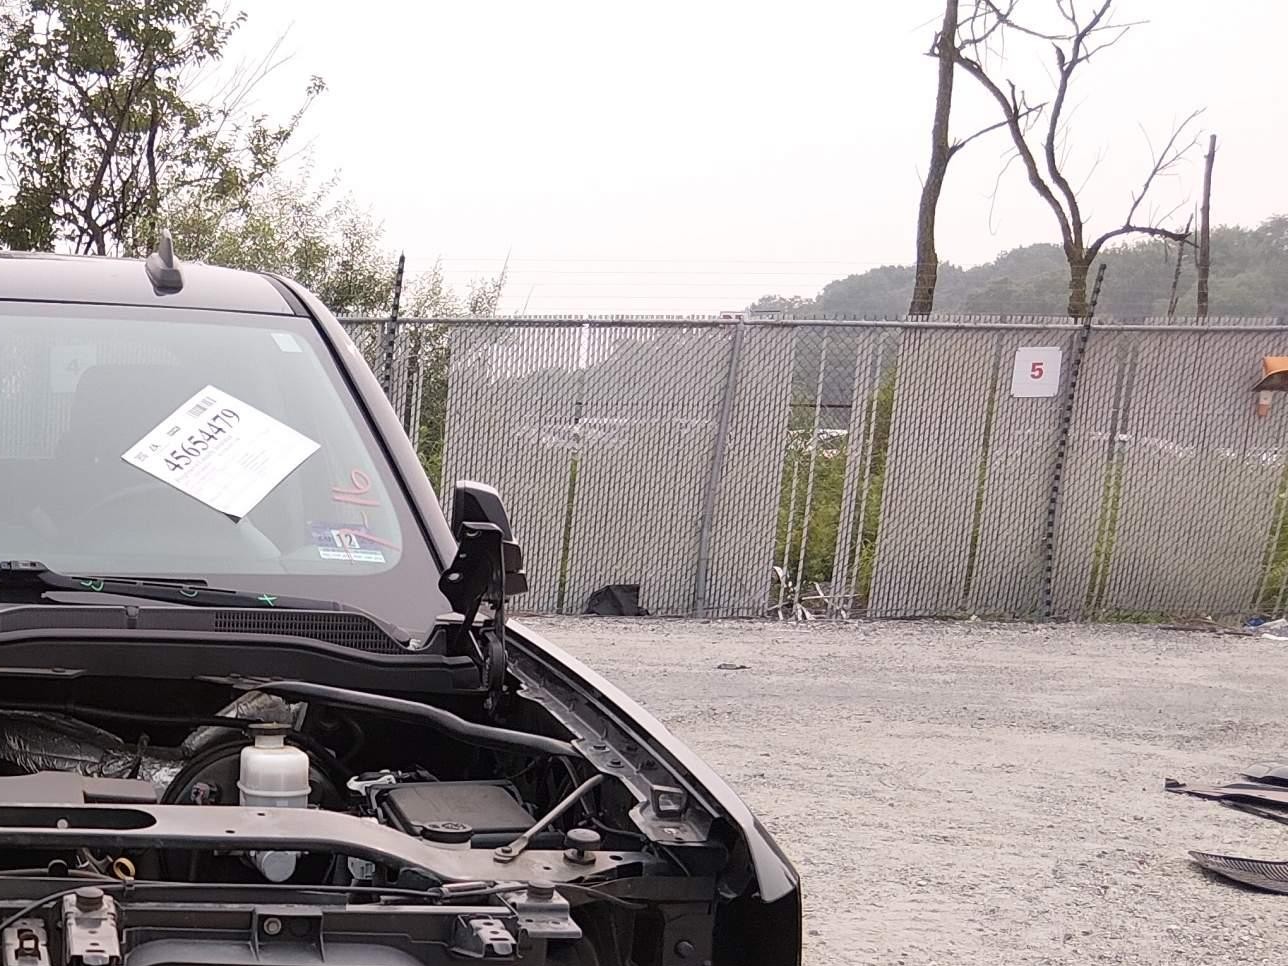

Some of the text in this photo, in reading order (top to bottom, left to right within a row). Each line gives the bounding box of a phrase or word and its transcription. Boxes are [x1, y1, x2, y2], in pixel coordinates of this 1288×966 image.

[1030, 362, 1044, 379] 5
[163, 408, 241, 472] 45654479
[336, 533, 358, 548] 12
